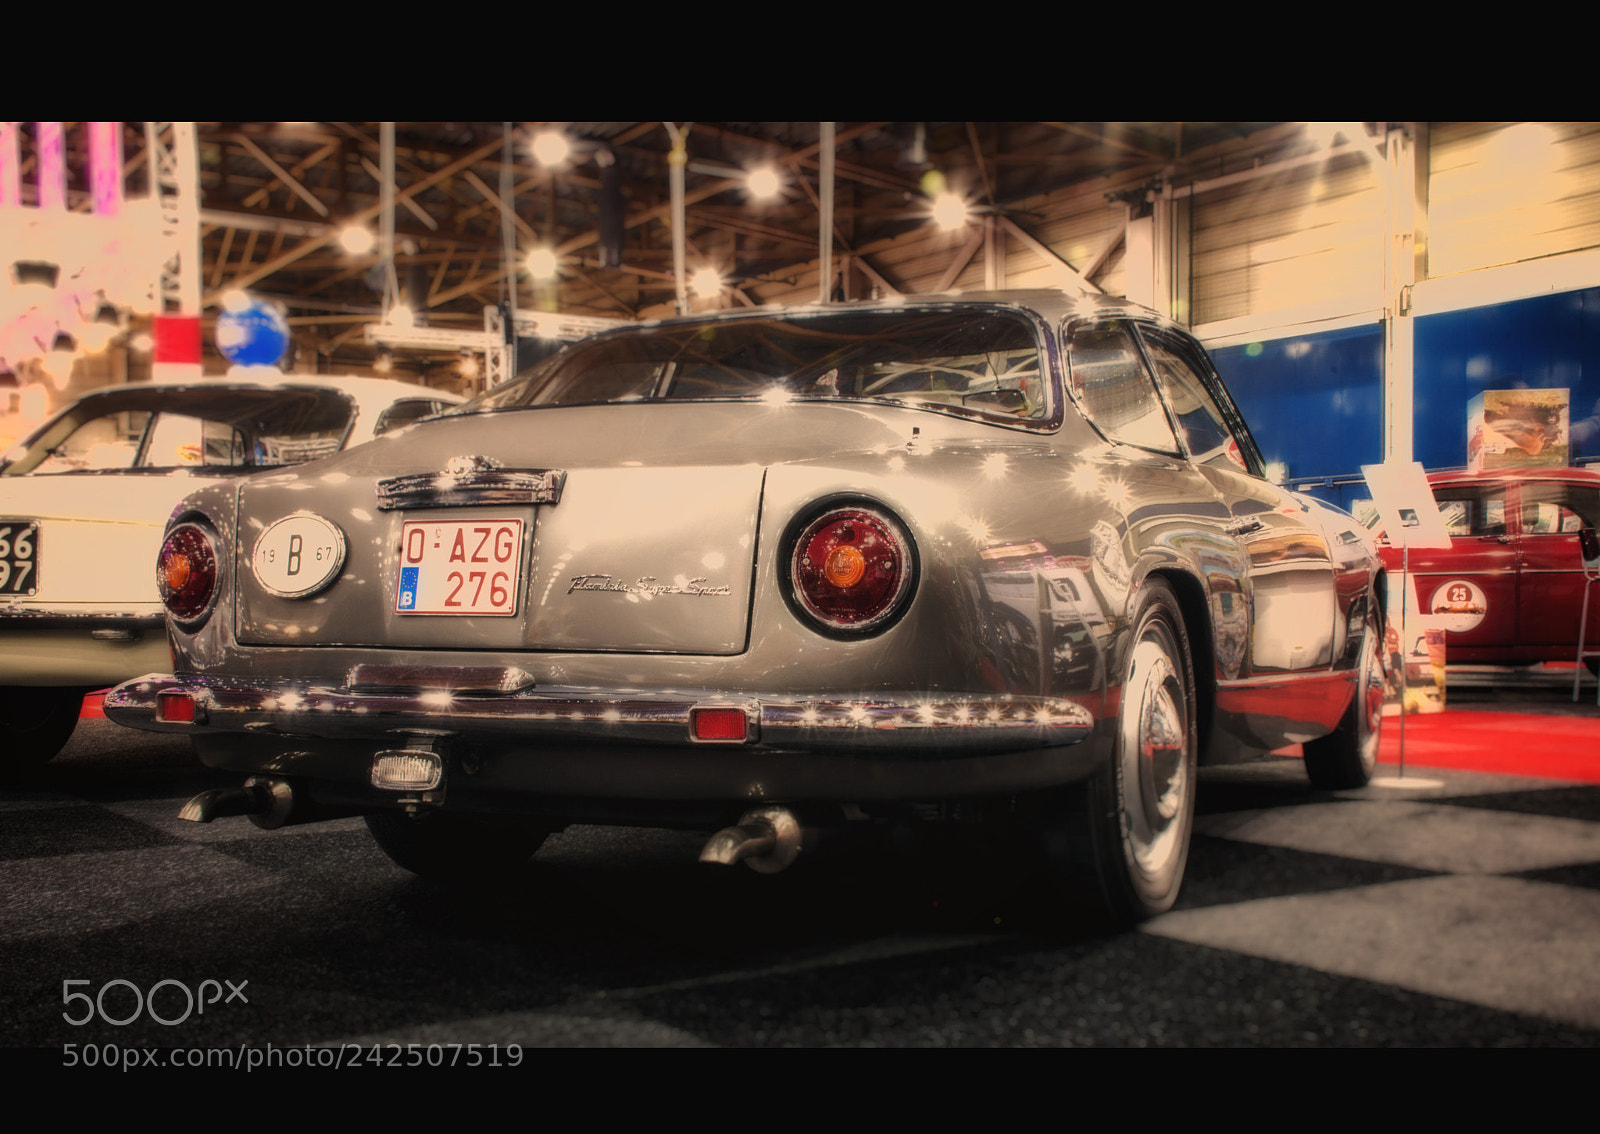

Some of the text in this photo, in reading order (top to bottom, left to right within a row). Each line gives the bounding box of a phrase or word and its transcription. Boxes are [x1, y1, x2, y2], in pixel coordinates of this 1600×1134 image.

[262, 534, 332, 576] 19 B 67
[0, 560, 33, 591] 97
[444, 571, 509, 607] 276
[400, 591, 413, 606] B
[1452, 587, 1467, 601] 25
